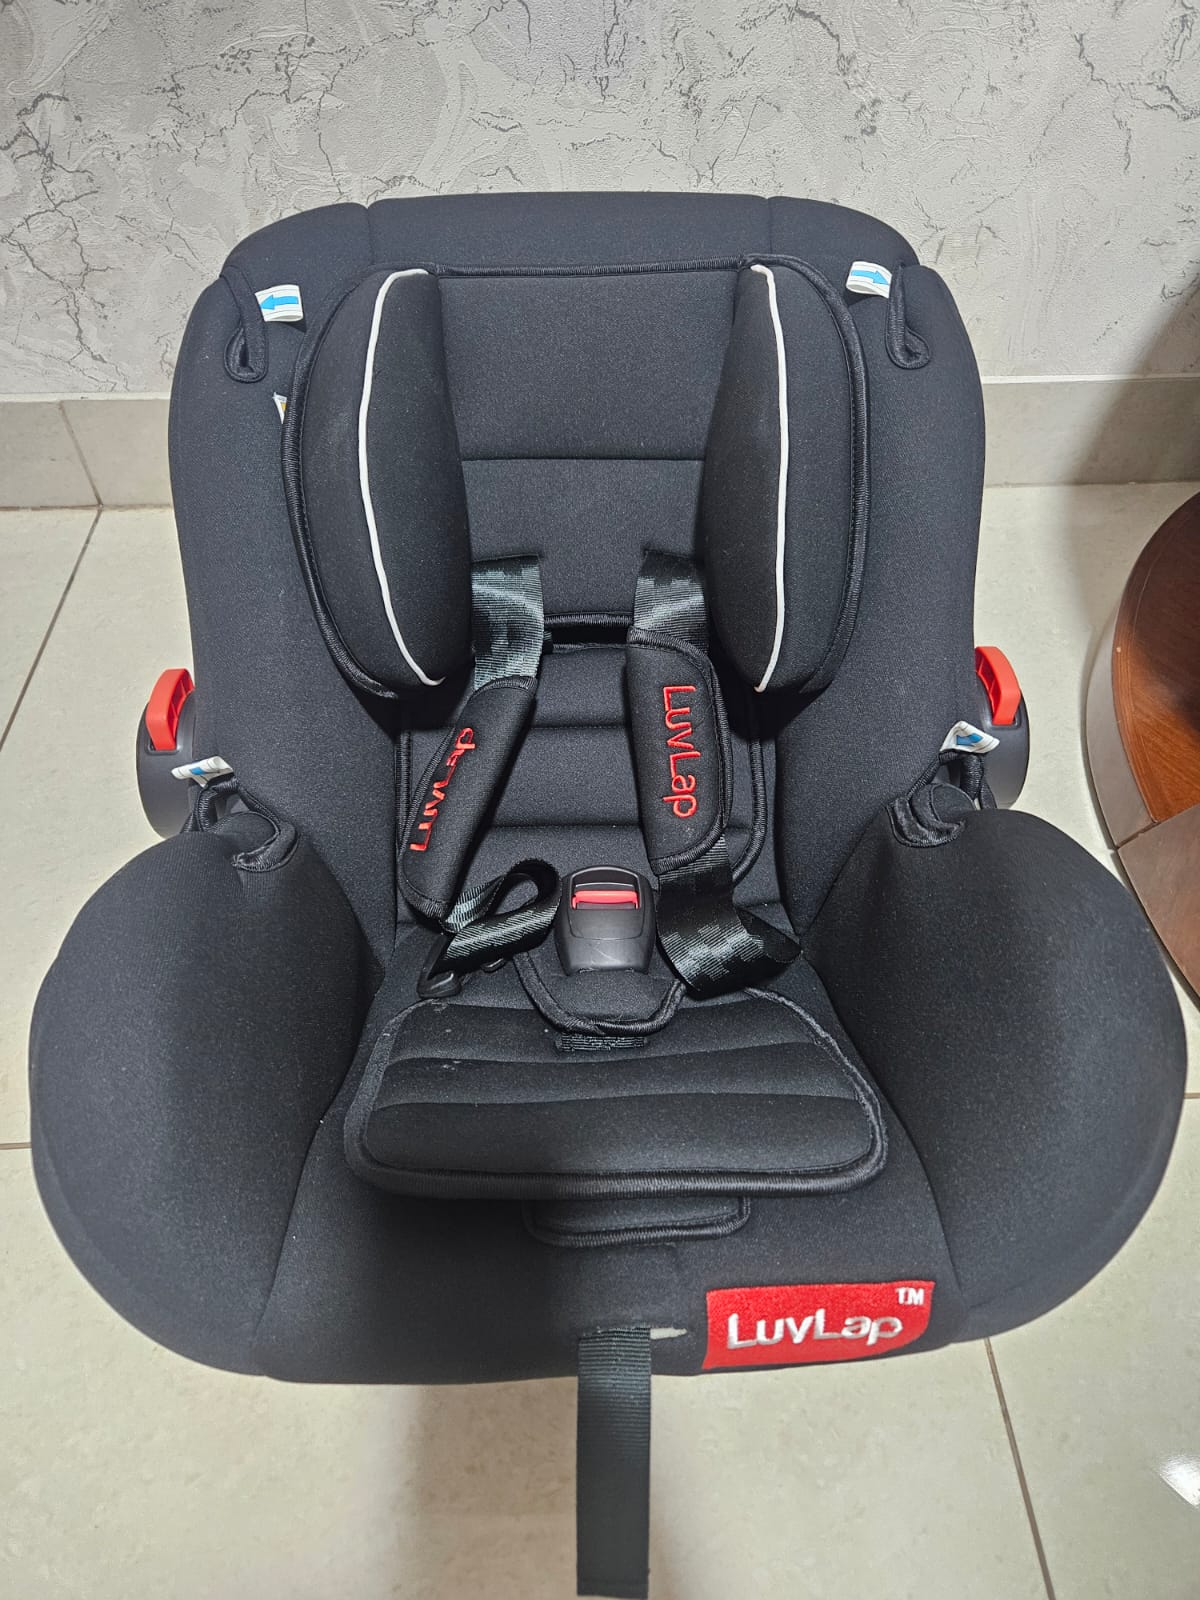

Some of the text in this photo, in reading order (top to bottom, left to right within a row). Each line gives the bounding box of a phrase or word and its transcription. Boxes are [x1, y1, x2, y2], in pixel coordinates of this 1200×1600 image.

[662, 685, 702, 818] LuvLap
[727, 1287, 925, 1350] LuvLap TM
